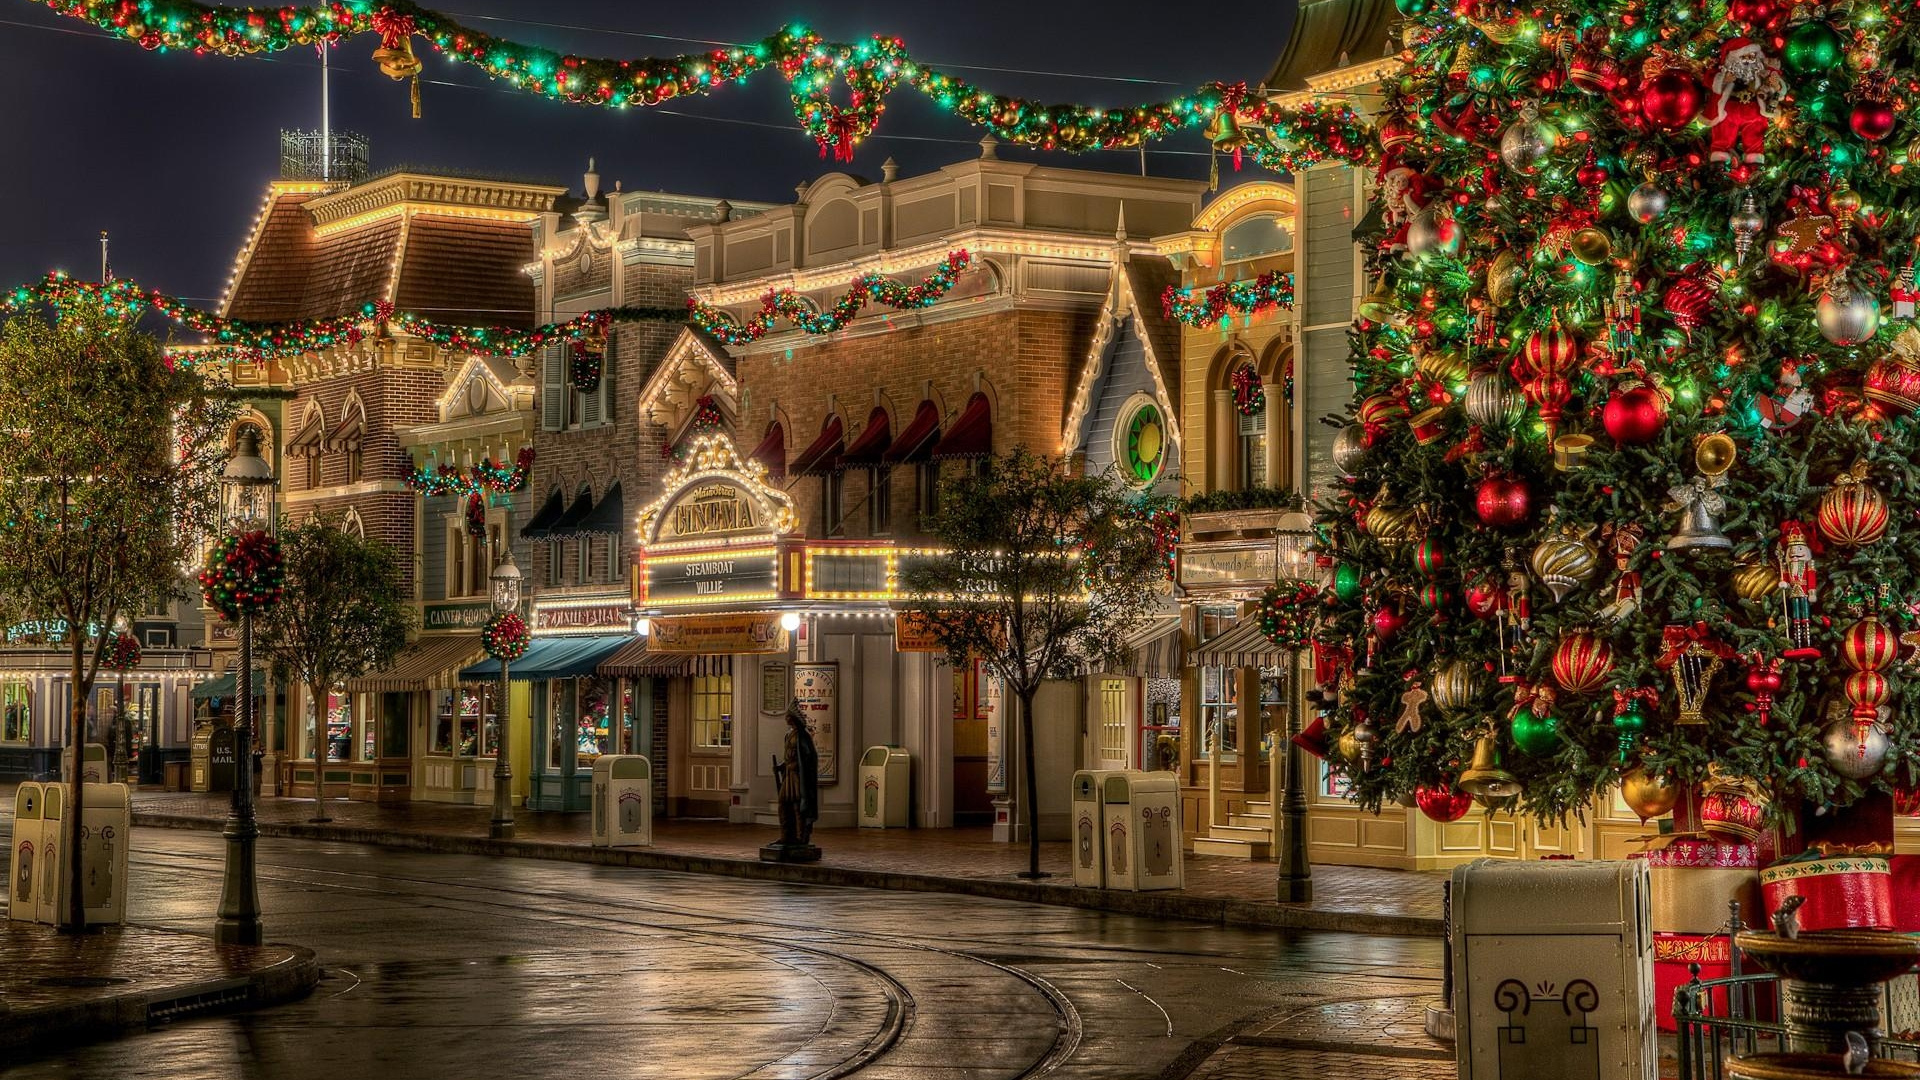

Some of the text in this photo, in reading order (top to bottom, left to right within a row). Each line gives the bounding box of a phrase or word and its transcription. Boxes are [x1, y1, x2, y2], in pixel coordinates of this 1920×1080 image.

[674, 499, 756, 536] CINEMA
[686, 561, 735, 577] STEAMBOAT
[1210, 553, 1242, 571] Sounds
[696, 580, 724, 595] WILLIE
[431, 610, 461, 625] CANNED
[796, 688, 833, 698] INEMA
[216, 746, 232, 755] U.S.
[212, 756, 236, 764] MAIL
